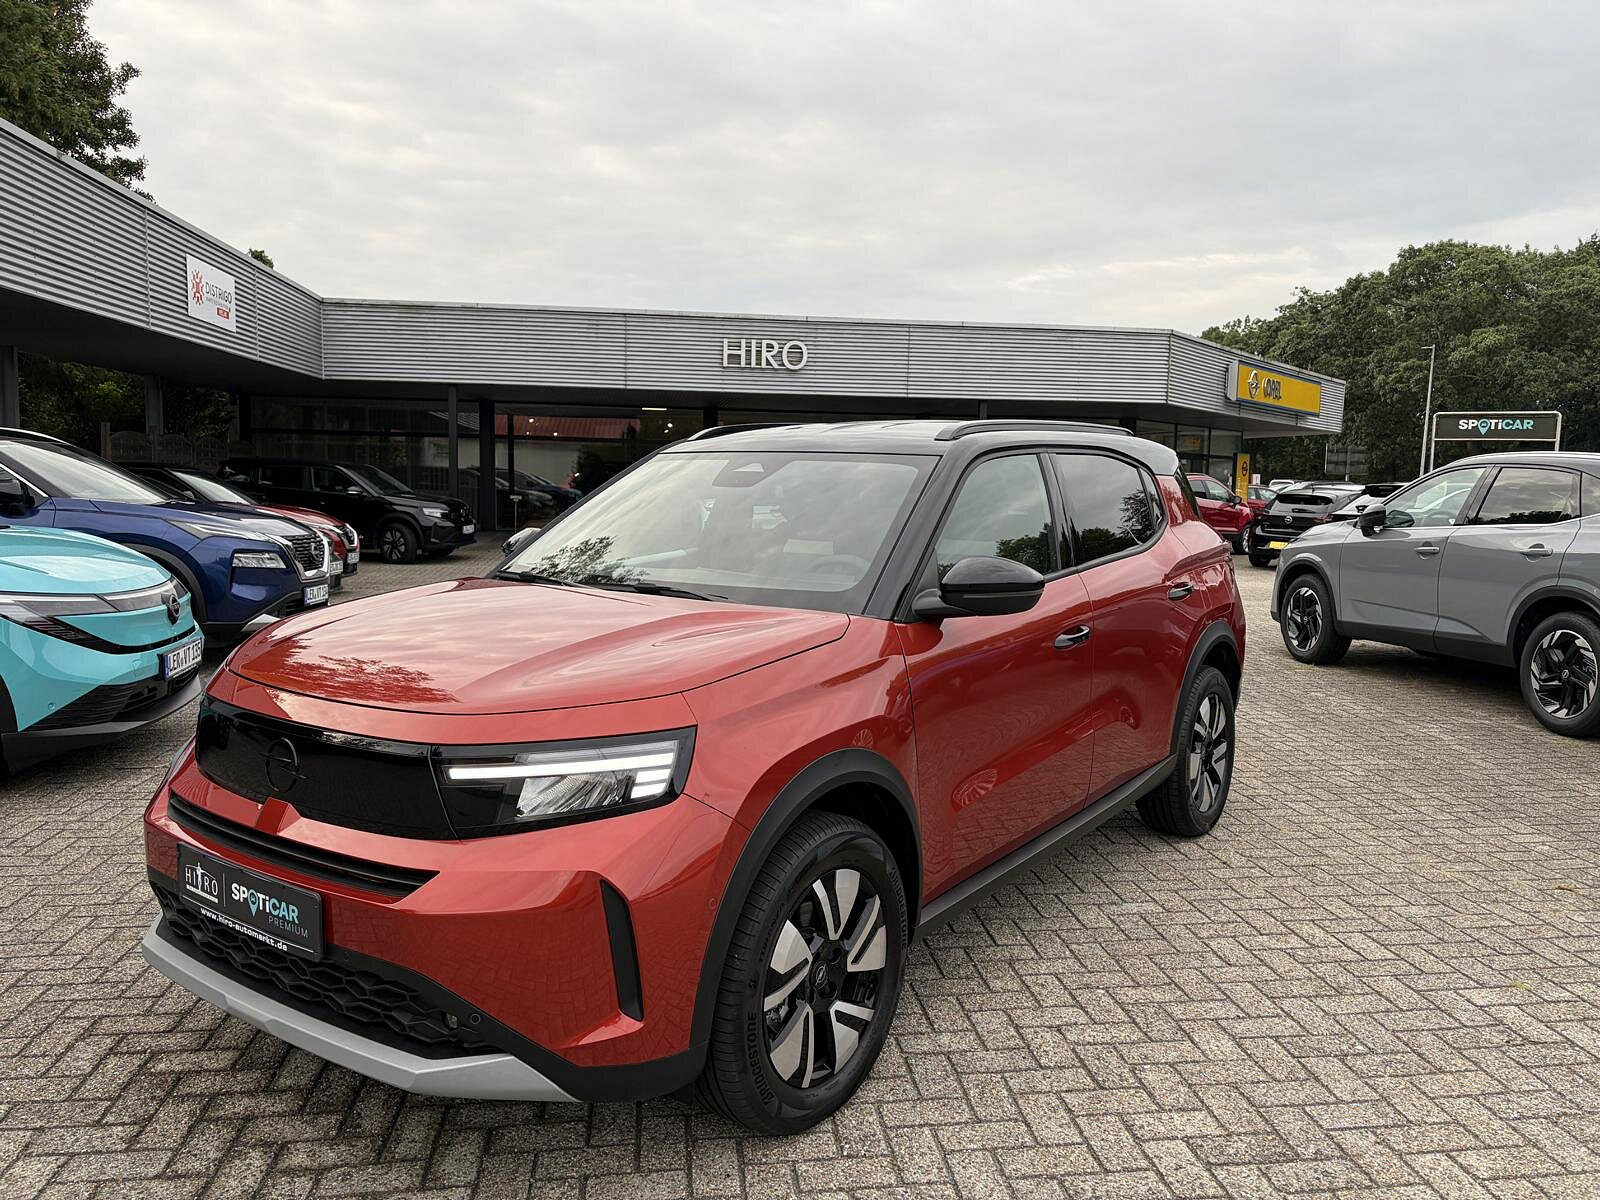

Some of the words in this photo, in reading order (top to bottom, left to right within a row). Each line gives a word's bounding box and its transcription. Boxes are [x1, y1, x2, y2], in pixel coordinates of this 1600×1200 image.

[205, 281, 233, 304] DISTRIGO
[722, 338, 808, 370] HIRO
[185, 866, 219, 896] HIRO
[200, 906, 288, 952] www.hiro-automarkt.de
[268, 915, 309, 939] PREMIUM
[747, 1011, 775, 1106] BRIDGESTONE
